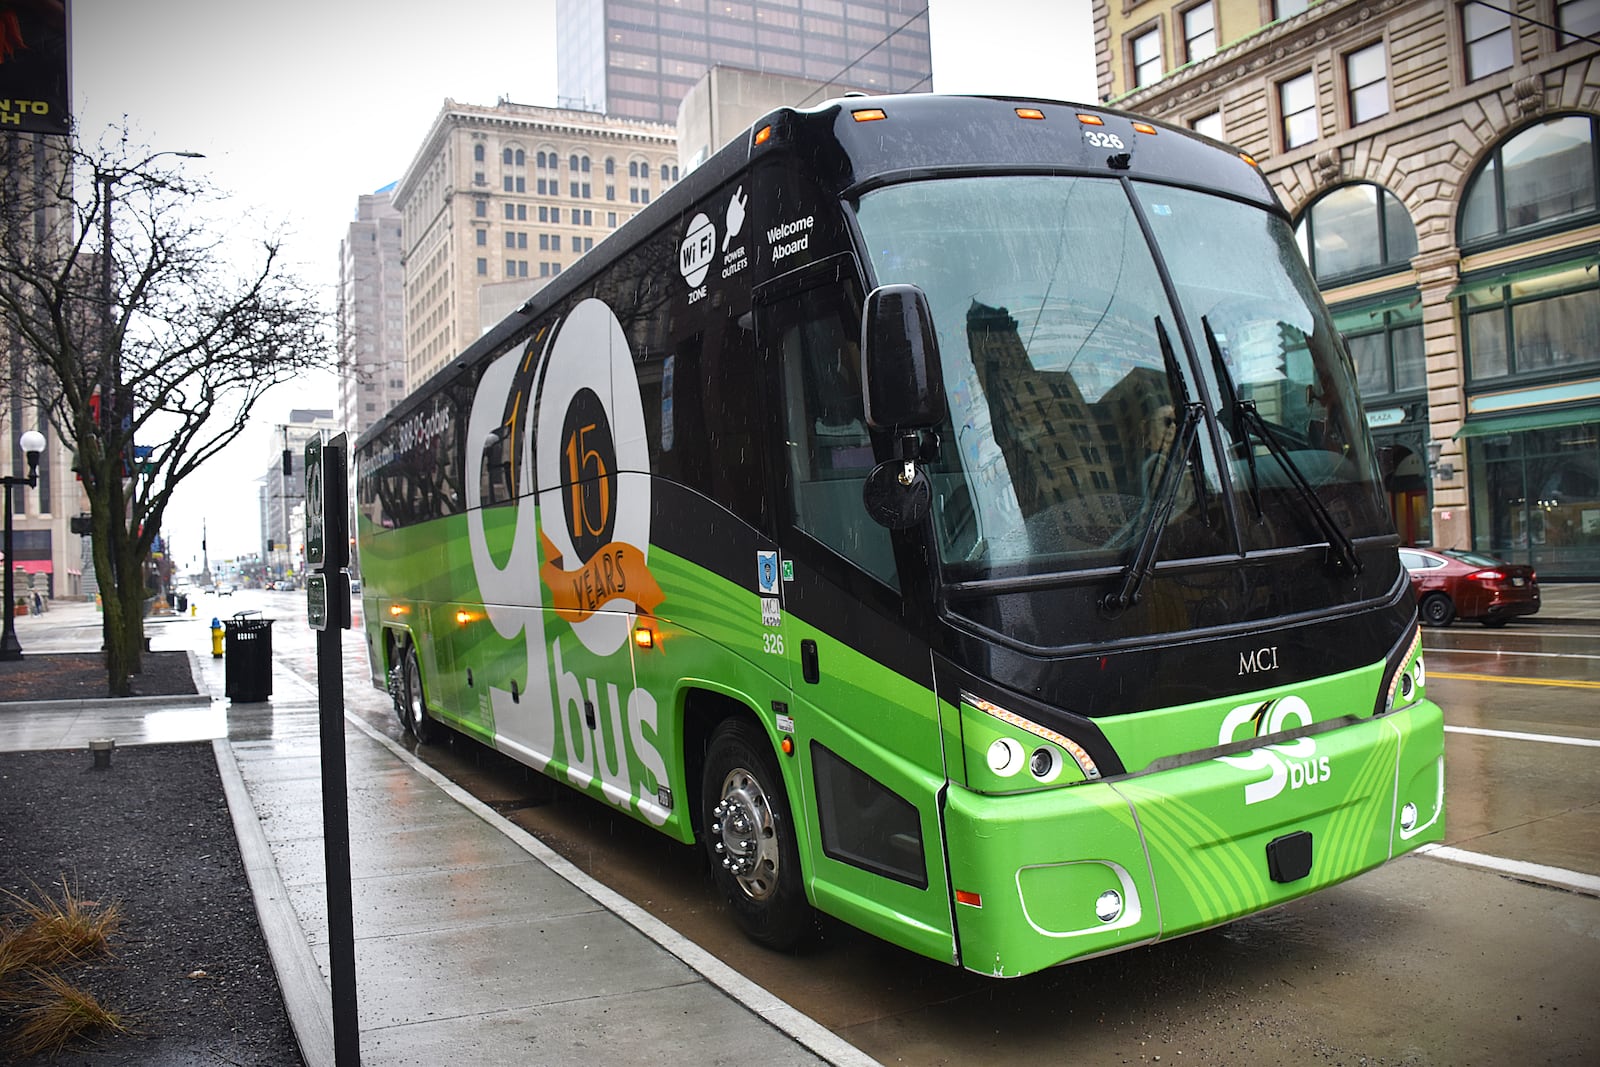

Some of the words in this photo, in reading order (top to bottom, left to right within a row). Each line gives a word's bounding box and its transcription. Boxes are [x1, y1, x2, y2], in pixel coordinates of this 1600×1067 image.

[0, 111, 20, 125] H
[15, 100, 49, 115] TO
[1085, 131, 1124, 150] 326
[767, 215, 814, 245] Welcome
[724, 246, 745, 266] POWER
[771, 234, 809, 262] Aboard
[721, 257, 748, 279] OUTLETS
[688, 285, 708, 304] ZONE
[1369, 412, 1393, 423] PLAZA
[566, 423, 609, 538] 15
[573, 549, 627, 616] YEARS
[762, 599, 780, 615] MCI
[762, 632, 785, 655] 326
[1238, 646, 1279, 676] MCI
[553, 635, 672, 827] bus
[1286, 755, 1331, 790] bus
